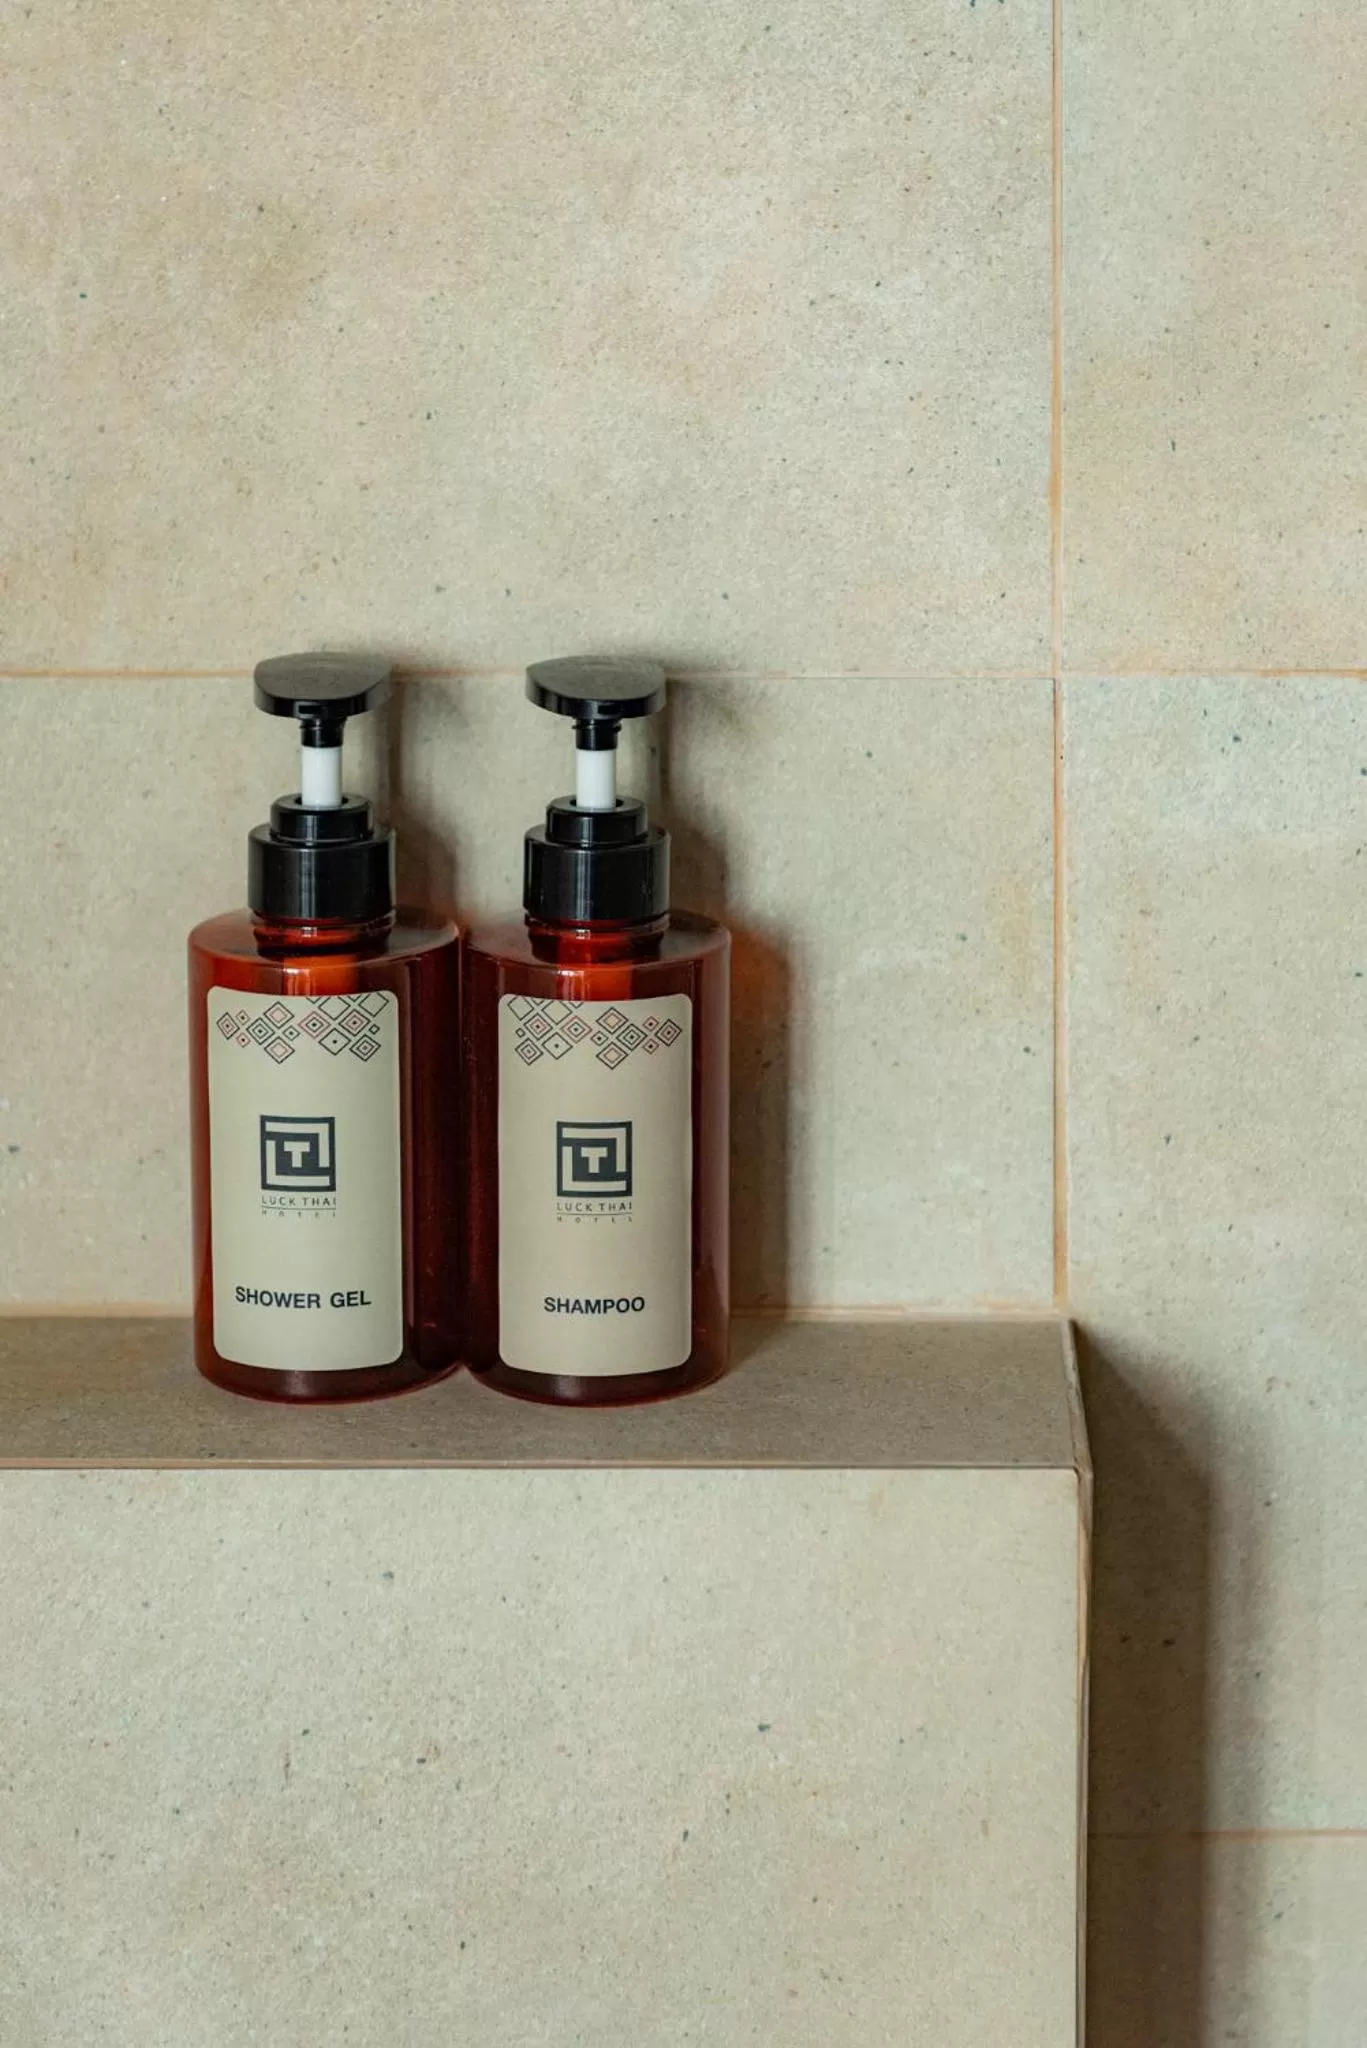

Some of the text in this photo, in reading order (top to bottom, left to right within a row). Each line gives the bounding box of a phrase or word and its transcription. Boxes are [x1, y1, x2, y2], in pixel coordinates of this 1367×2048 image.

[261, 1195, 336, 1206] LUCK THAI
[556, 1201, 633, 1212] LUCK THAI
[235, 1285, 372, 1309] SHOWER GEL
[543, 1296, 645, 1315] SHAMPOO
